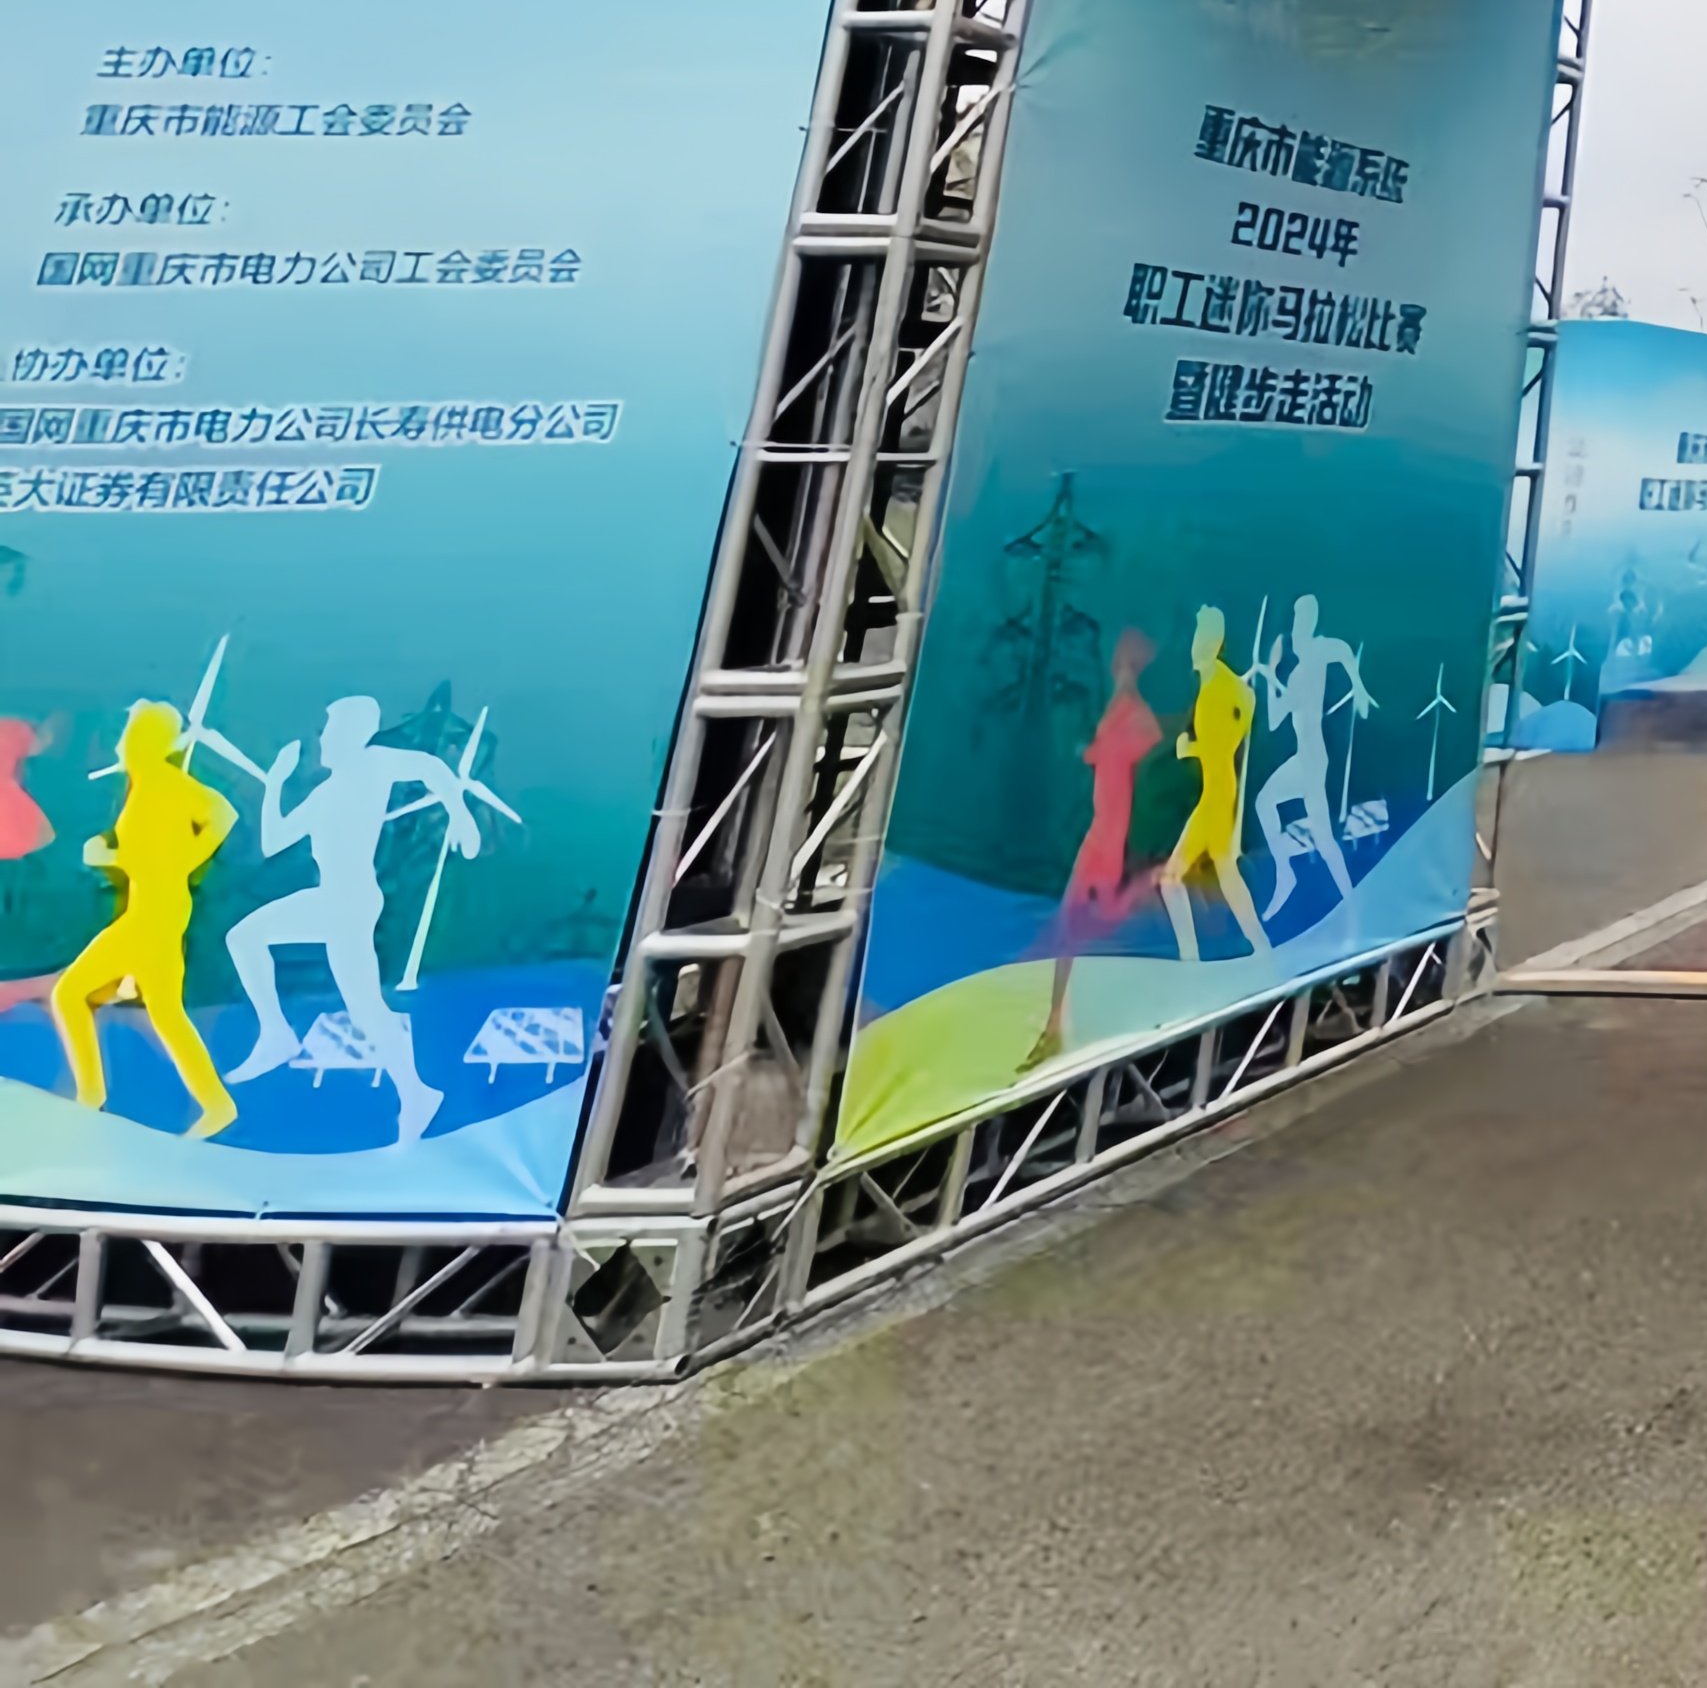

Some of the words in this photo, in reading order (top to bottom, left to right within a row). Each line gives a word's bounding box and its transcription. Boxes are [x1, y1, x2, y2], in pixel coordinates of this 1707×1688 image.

[80, 103, 472, 136] 重庆市能源工会委员会
[37, 249, 581, 286] 国网重庆市电力公司工会委员会
[1231, 201, 1360, 268] 2024年
[1124, 263, 1427, 355] 职工迷你马拉松比赛
[1164, 359, 1373, 429] 暨健步走活动
